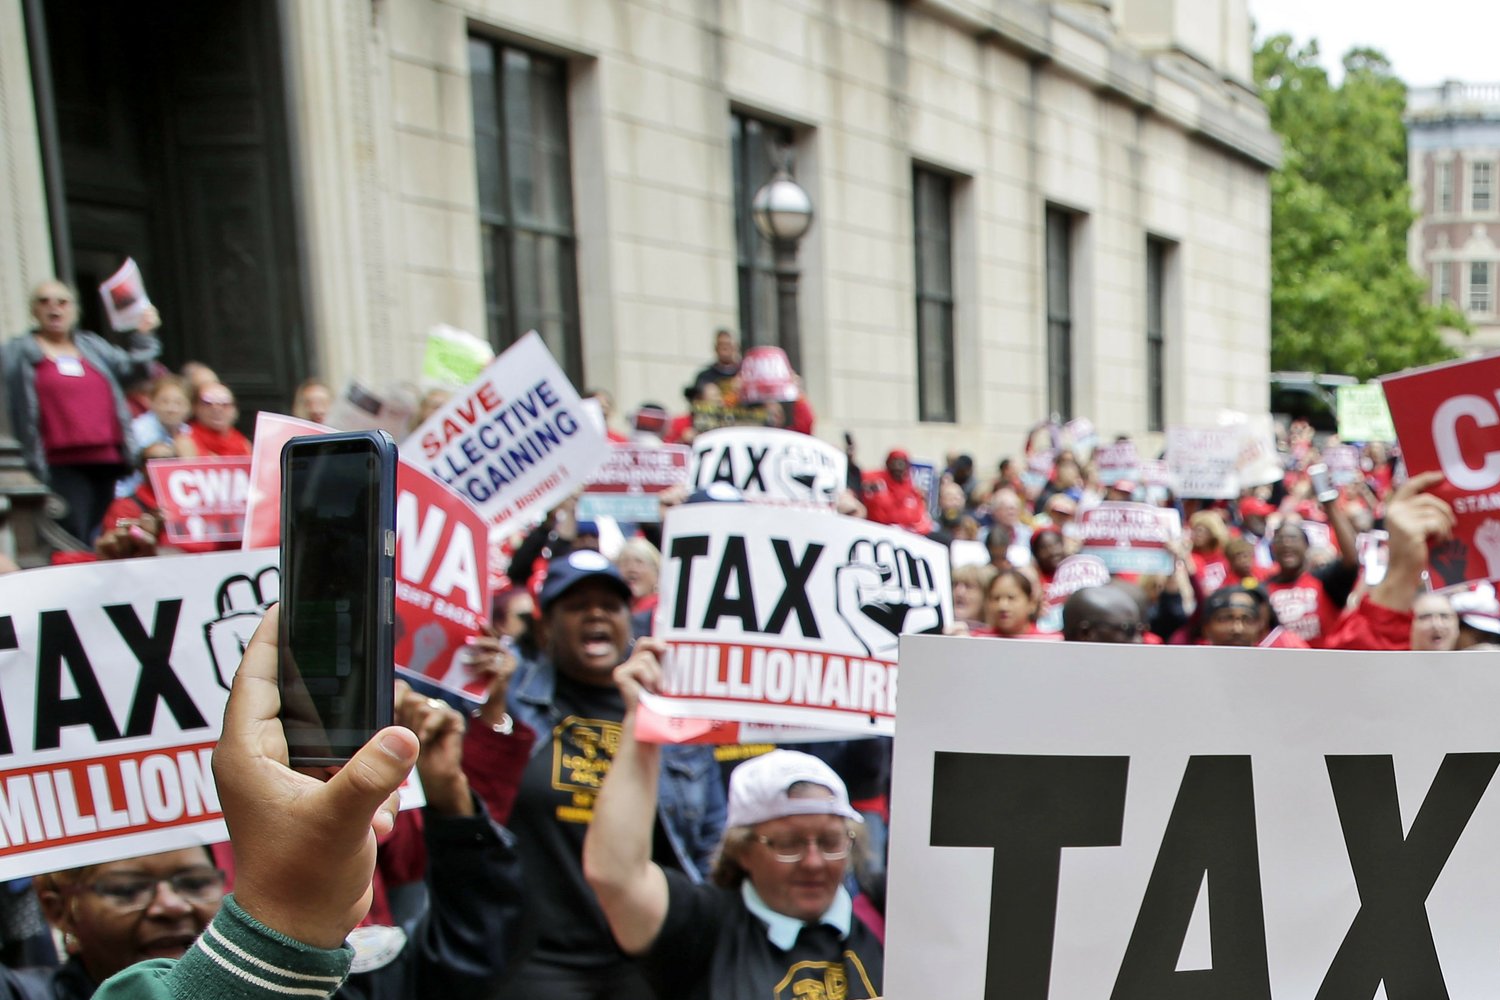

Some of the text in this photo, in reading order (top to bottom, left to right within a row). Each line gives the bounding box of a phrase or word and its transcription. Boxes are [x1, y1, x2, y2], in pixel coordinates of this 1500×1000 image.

[421, 382, 502, 460] SAVE
[431, 380, 559, 484] LLECTIVE
[464, 410, 579, 503] GAINING
[695, 446, 770, 492] TAX
[168, 468, 250, 508] CWA
[398, 489, 483, 614] WA
[671, 535, 825, 640] TAX
[0, 748, 223, 848] MILLION
